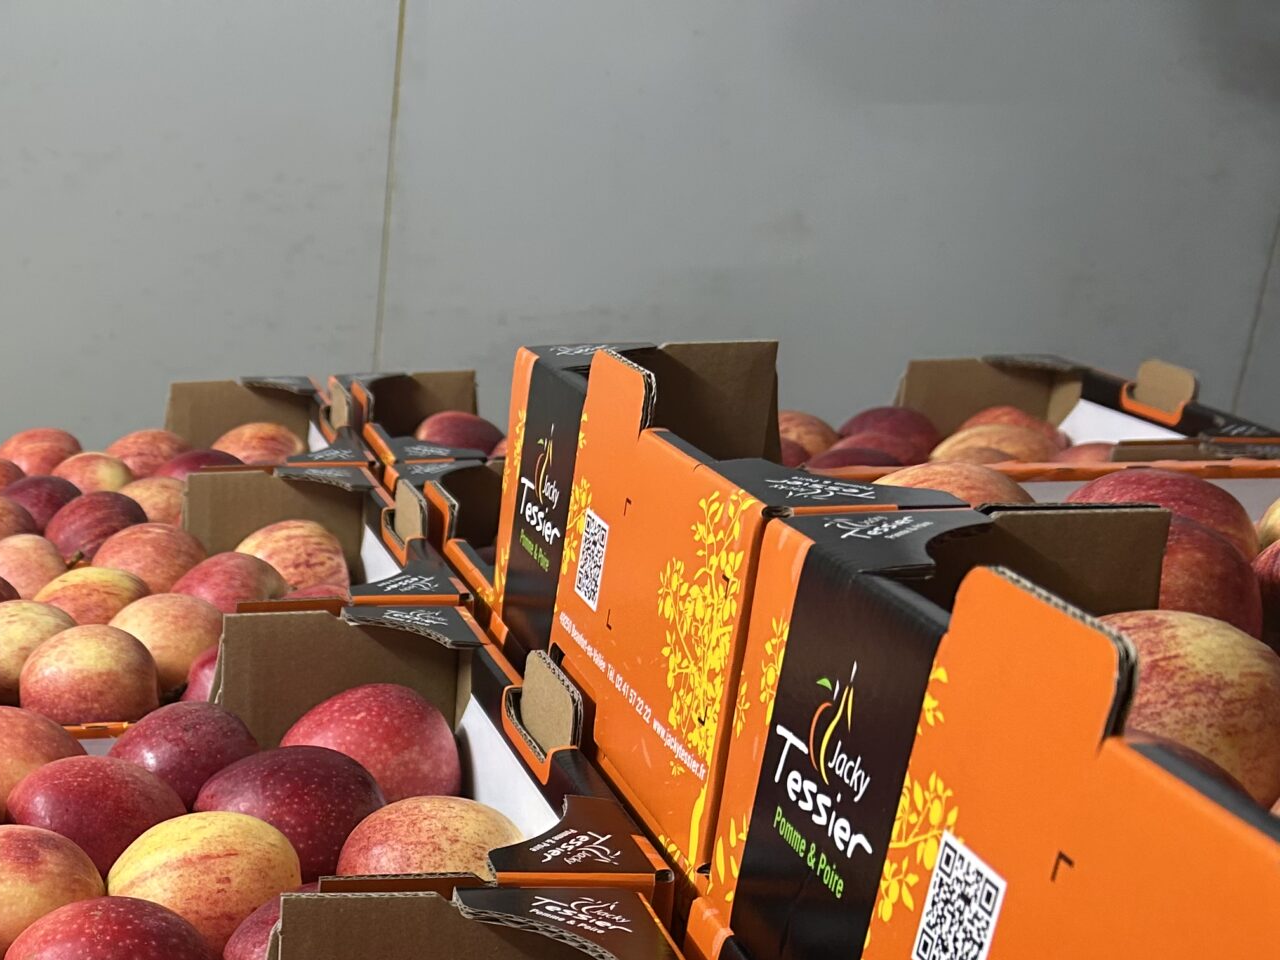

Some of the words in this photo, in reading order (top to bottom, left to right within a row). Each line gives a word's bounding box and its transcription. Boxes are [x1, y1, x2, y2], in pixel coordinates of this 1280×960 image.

[520, 477, 561, 545] Tessier
[542, 475, 559, 510] Jacky
[614, 673, 622, 691] 02
[622, 682, 629, 698] 41
[628, 690, 637, 705] 57
[635, 696, 644, 715] 22
[643, 705, 652, 724] 22
[652, 718, 707, 781] www.jackytessier.fr
[774, 724, 873, 859] Tessier
[827, 740, 870, 803] Jacky
[541, 831, 613, 863] Tessier
[773, 805, 807, 859] Pomme
[806, 842, 817, 870] &
[817, 851, 845, 899] Poire
[531, 896, 633, 933] Tessier
